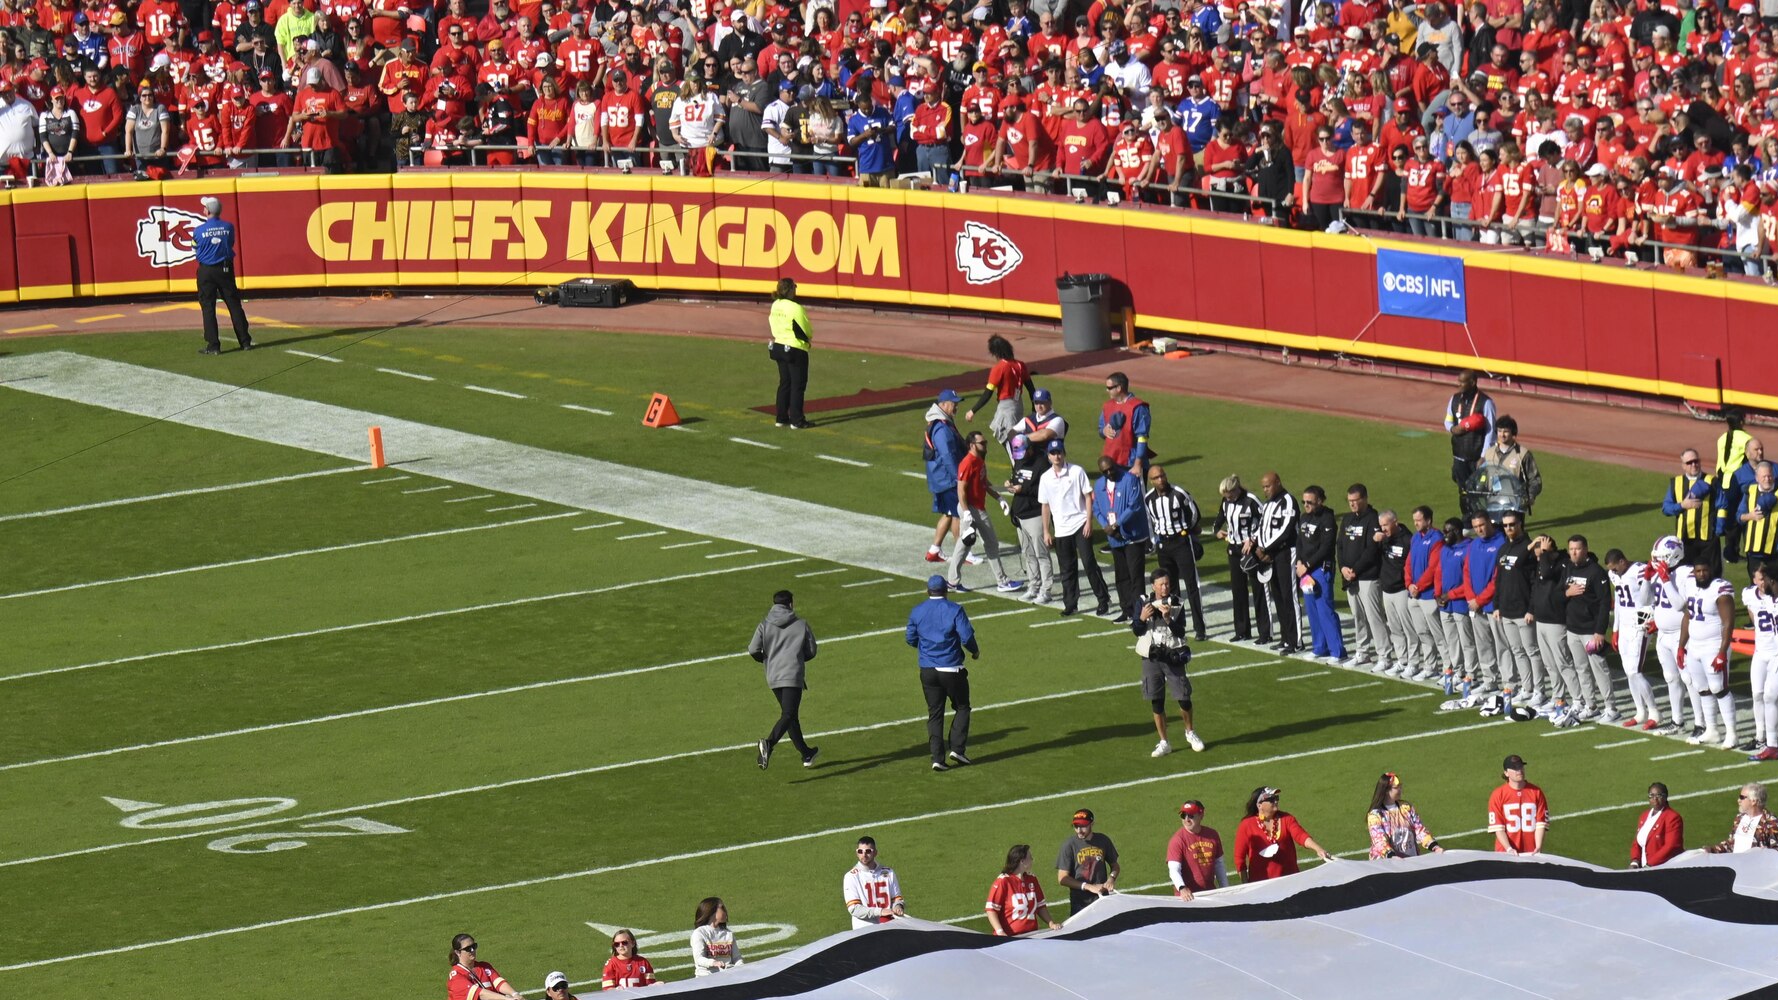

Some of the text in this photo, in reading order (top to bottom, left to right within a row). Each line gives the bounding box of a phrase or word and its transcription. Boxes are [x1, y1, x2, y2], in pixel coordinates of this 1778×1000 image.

[225, 14, 242, 31] 15
[568, 50, 590, 73] 15
[941, 41, 963, 62] 15
[1214, 79, 1232, 101] 15
[1592, 88, 1607, 107] 15
[608, 106, 629, 128] 58
[1183, 112, 1203, 133] 17
[194, 130, 216, 150] 15
[1351, 155, 1367, 178] 15
[1502, 174, 1520, 195] 15
[202, 230, 230, 238] SECURITY
[307, 200, 901, 278] CHIEFS KINGDOM
[1396, 273, 1461, 299] CBS NFL
[646, 397, 663, 425] G
[1615, 585, 1636, 608] 21
[1503, 802, 1537, 832] 58
[864, 882, 889, 909] 15
[1012, 897, 1037, 921] 87
